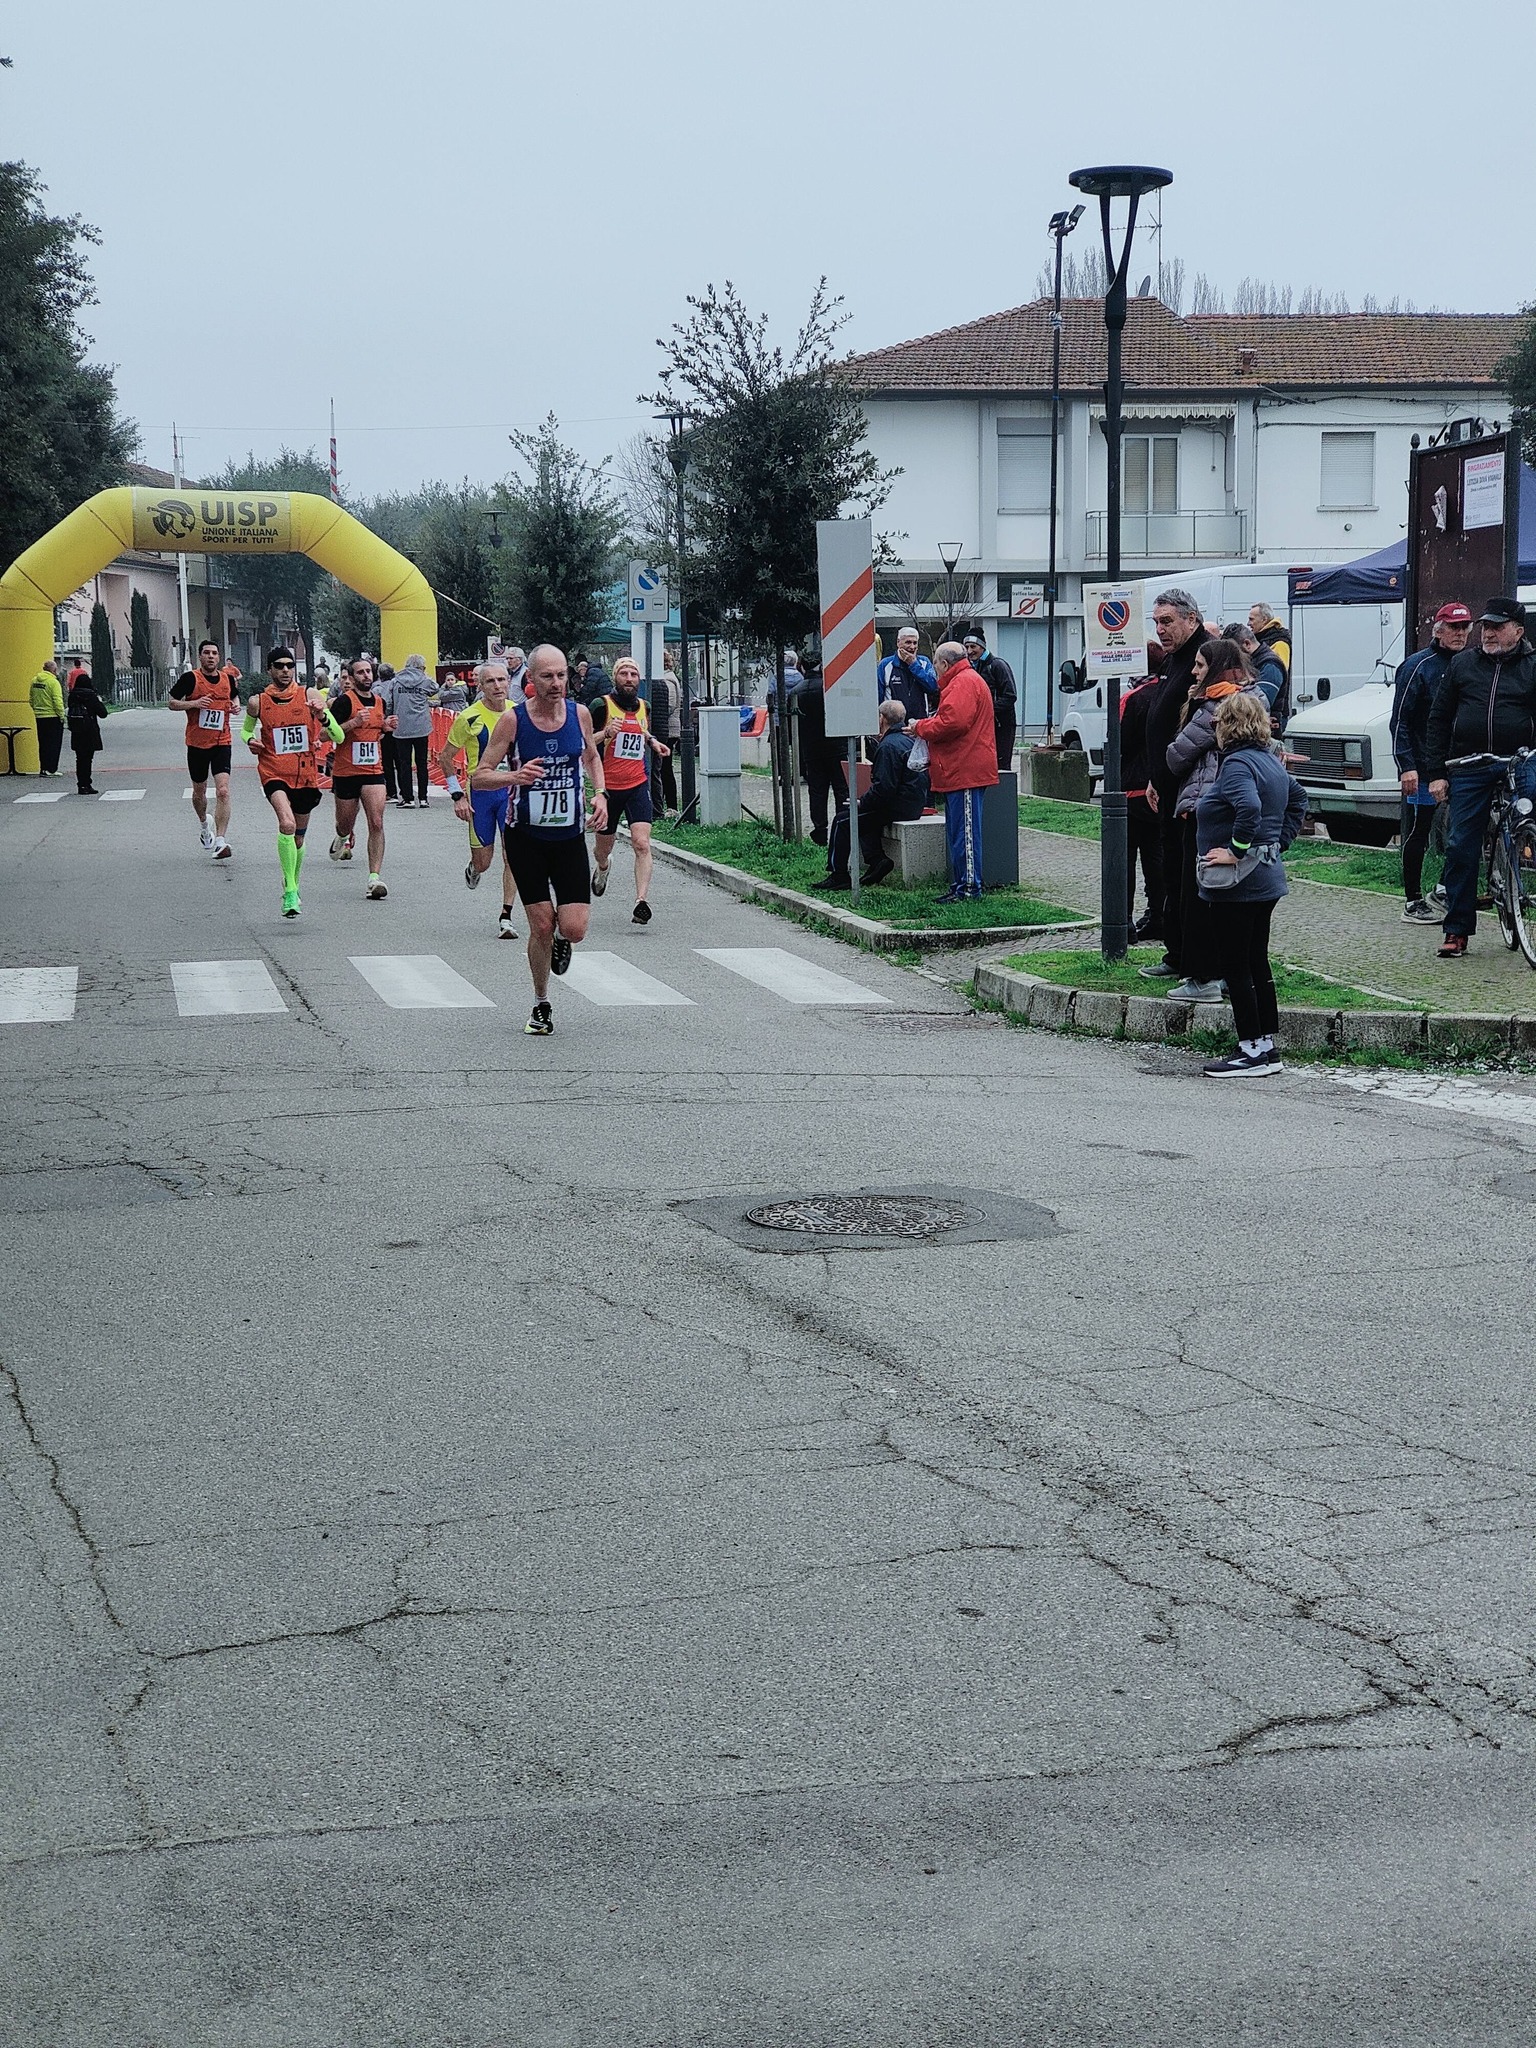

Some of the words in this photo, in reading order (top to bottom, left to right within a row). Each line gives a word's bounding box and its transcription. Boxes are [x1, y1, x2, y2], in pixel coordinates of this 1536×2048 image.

[201, 500, 277, 526] UISP
[202, 527, 236, 536] UNIONE
[240, 528, 278, 536] ITALIANA
[202, 535, 229, 543] SPORT
[634, 600, 642, 609] P
[206, 710, 221, 723] 737
[281, 727, 303, 744] 755
[622, 734, 642, 751] 623
[360, 743, 374, 757] 614
[542, 764, 574, 778] eltic
[541, 791, 568, 814] 778
